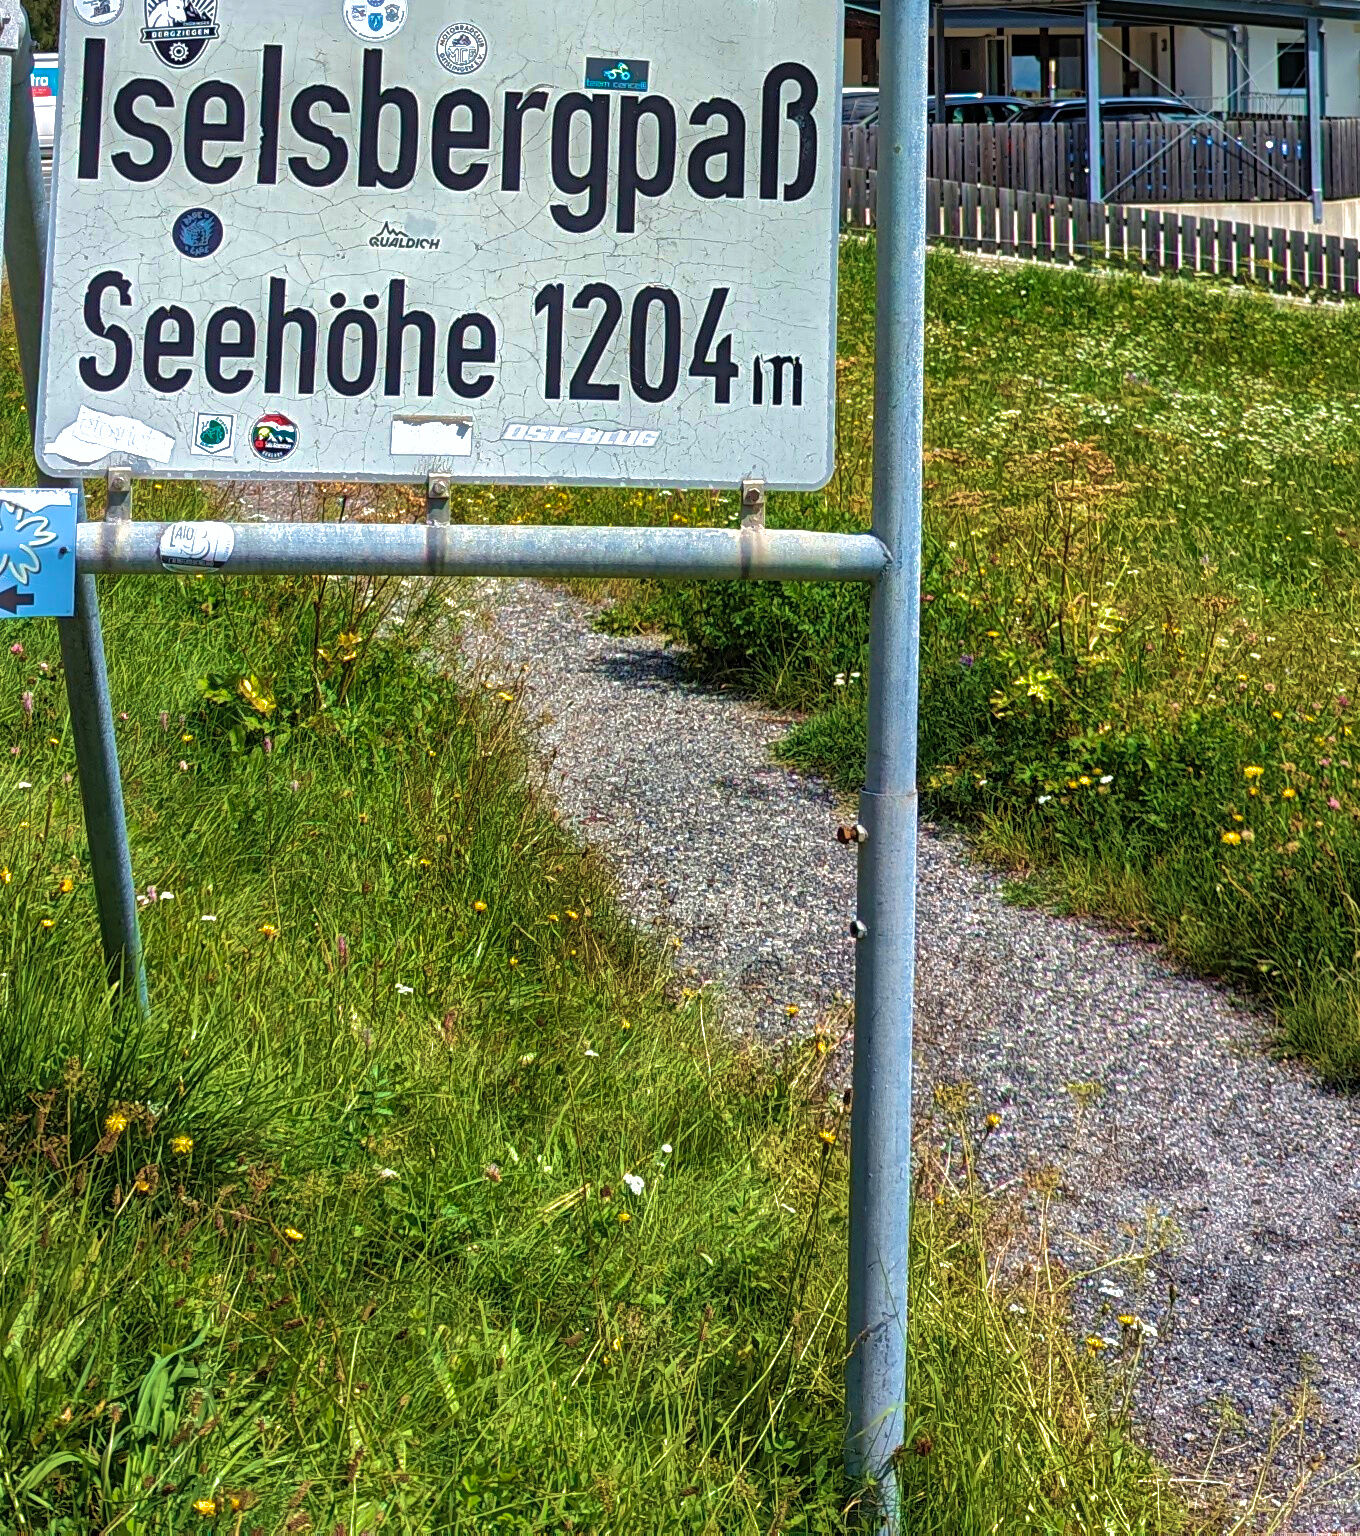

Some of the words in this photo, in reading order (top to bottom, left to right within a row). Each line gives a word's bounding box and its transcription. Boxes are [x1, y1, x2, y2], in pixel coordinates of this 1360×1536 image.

[78, 38, 819, 234] Iselsbergpaß
[369, 236, 441, 250] QUALDICH
[78, 269, 497, 401] Seehöhe
[535, 282, 739, 406] 1204
[752, 353, 804, 407] m
